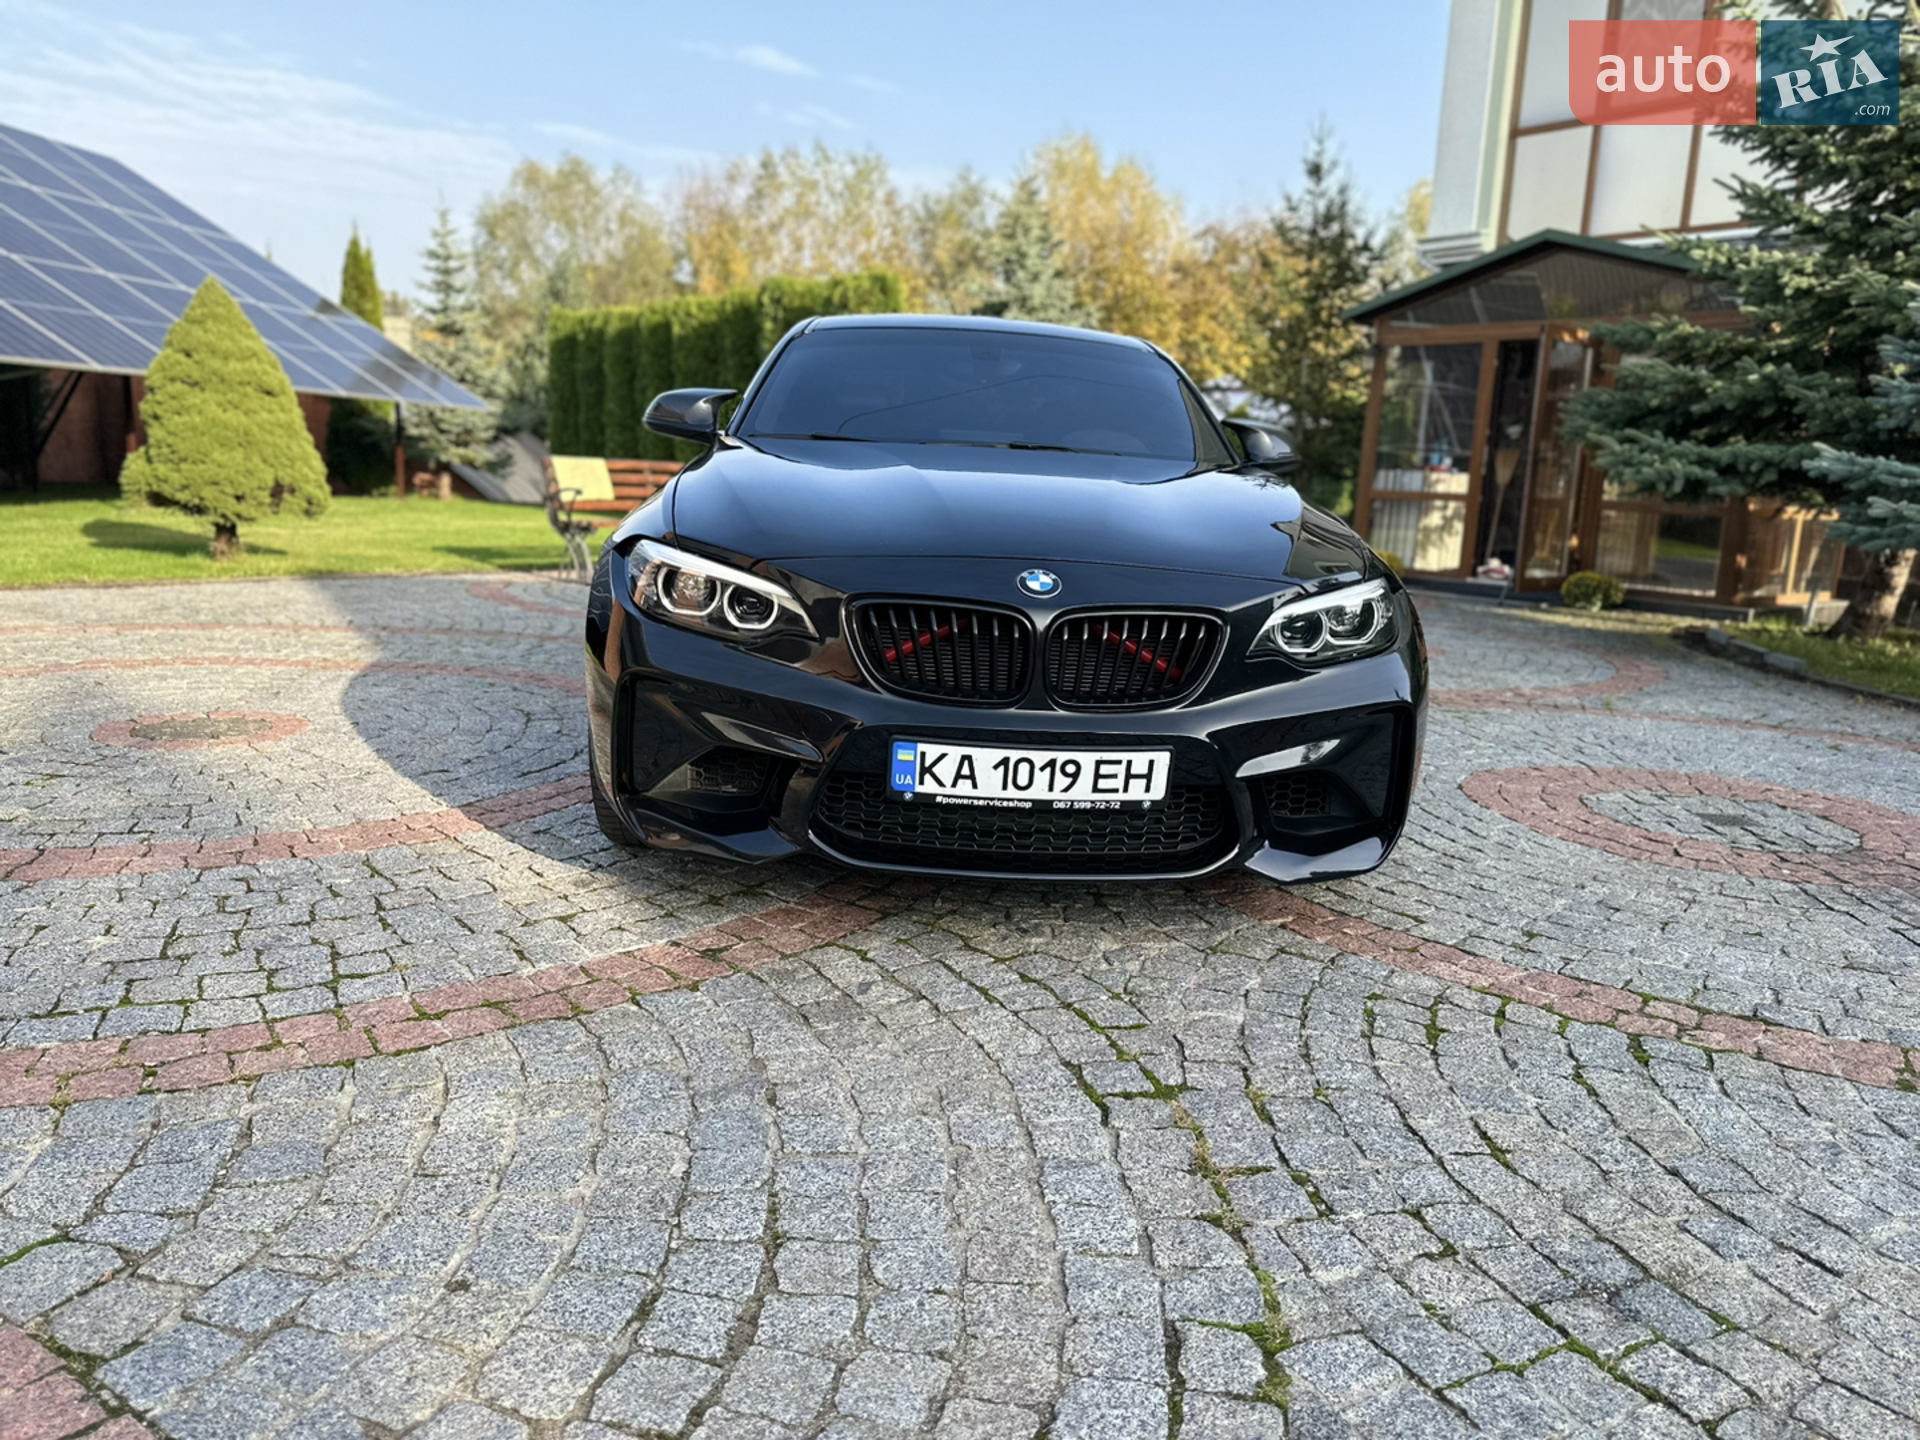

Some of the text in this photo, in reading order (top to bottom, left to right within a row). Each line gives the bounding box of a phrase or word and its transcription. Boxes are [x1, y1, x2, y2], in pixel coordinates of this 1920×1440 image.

[918, 750, 1156, 794] KA 1019 EH
[895, 773, 914, 785] UA
[935, 795, 1033, 809] #powerserviceshop
[1052, 801, 1072, 809] 067
